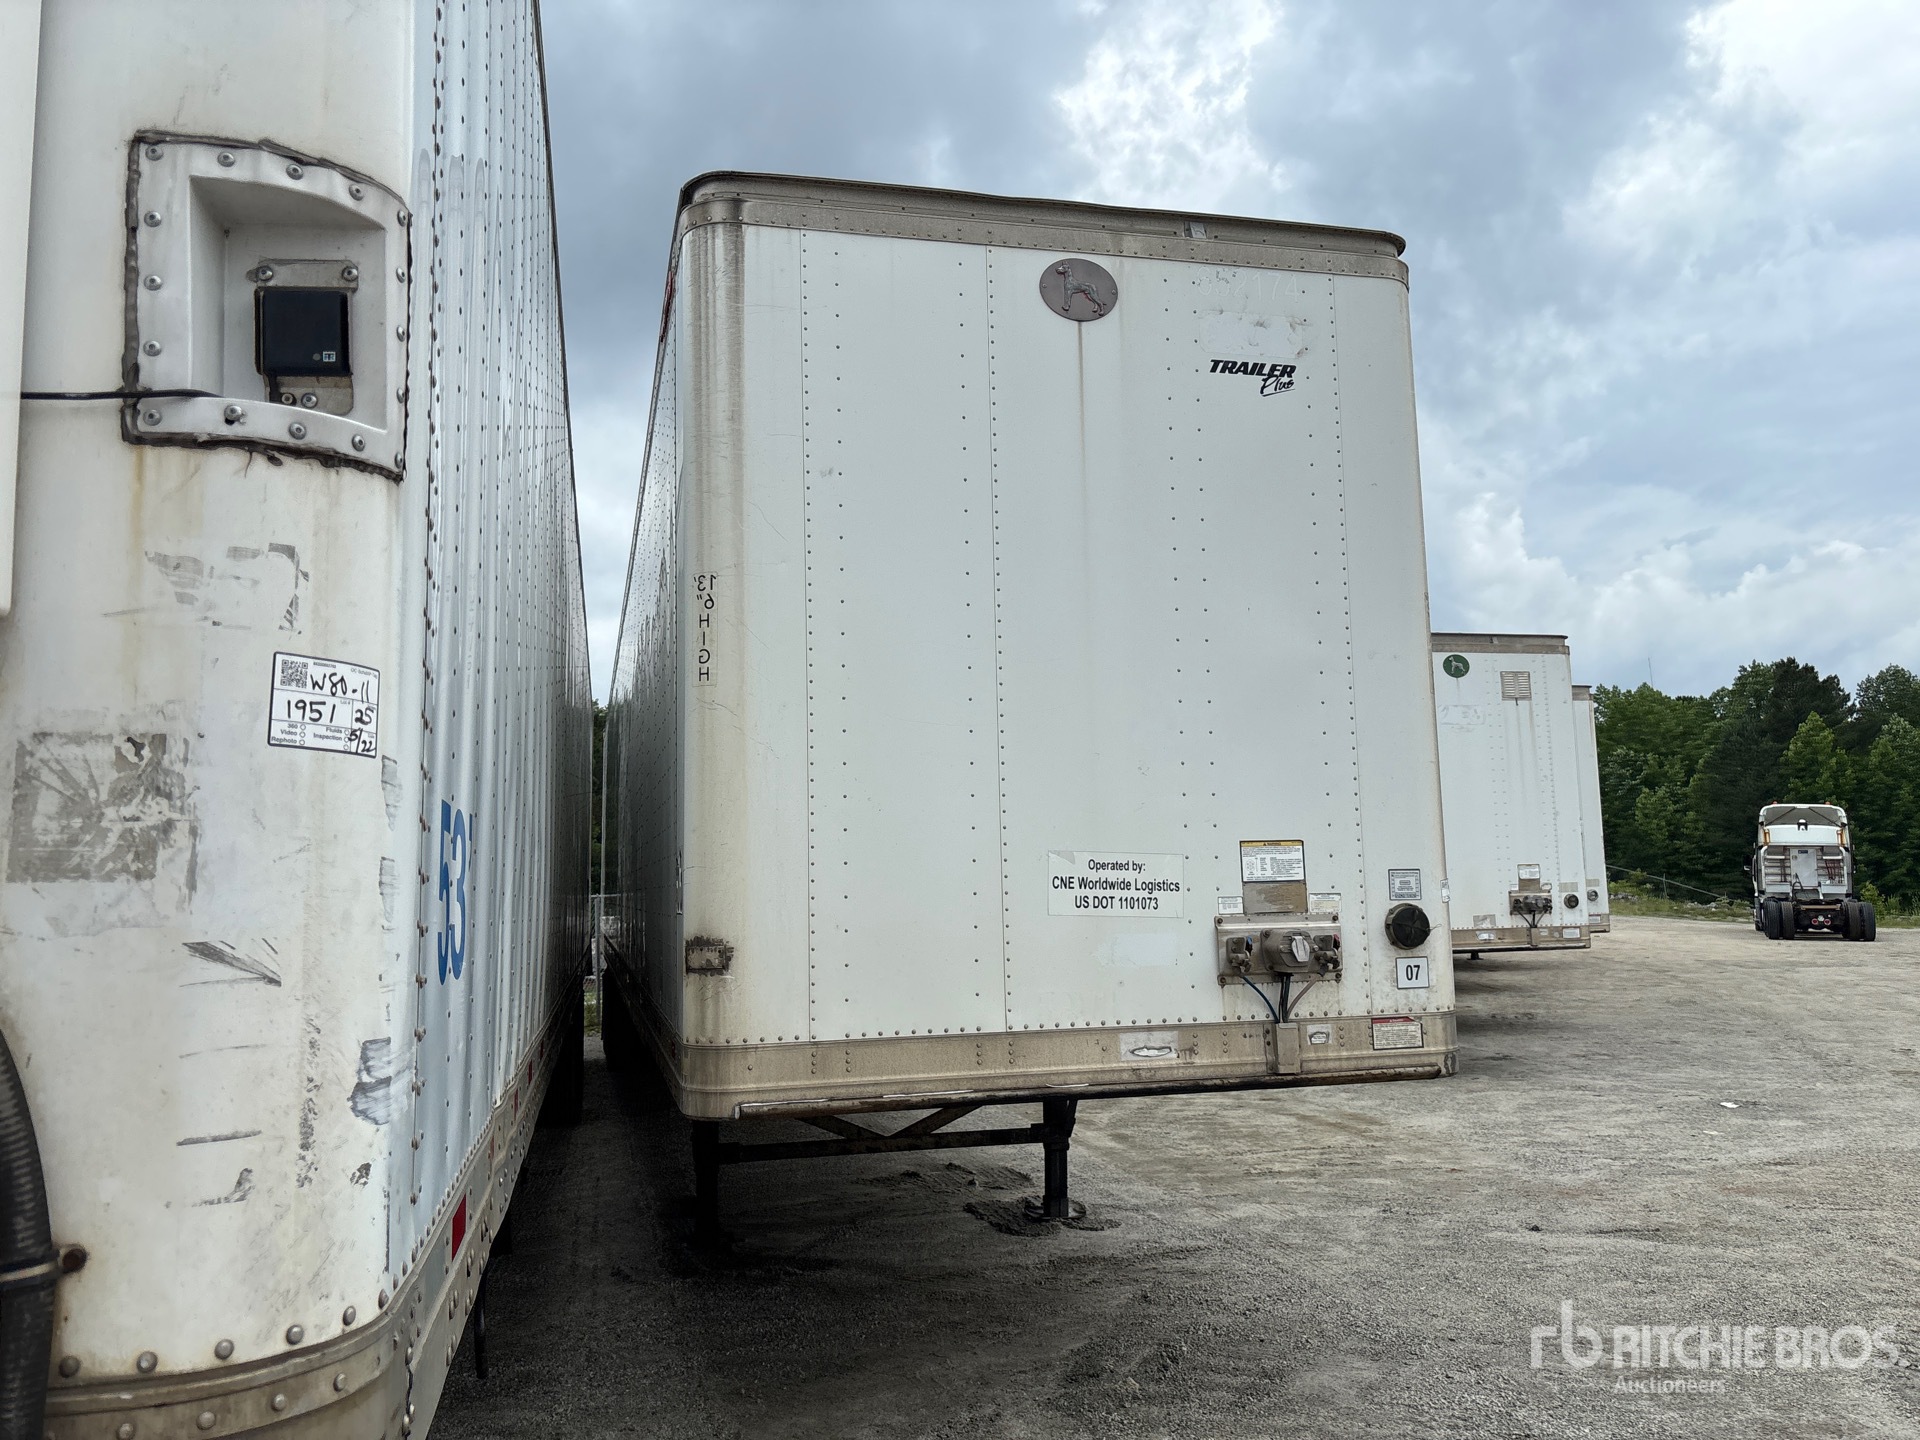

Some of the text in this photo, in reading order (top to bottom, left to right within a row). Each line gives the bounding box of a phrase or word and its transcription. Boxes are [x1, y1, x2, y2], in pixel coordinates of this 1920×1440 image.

[1209, 359, 1297, 378] TRAILER
[1259, 375, 1295, 396] Plus
[287, 699, 336, 723] 1951
[354, 707, 374, 725] 25
[271, 736, 298, 744] Rephoto
[313, 733, 343, 741] Inspection
[1088, 858, 1146, 874] Operated by:
[1052, 875, 1181, 895] CNE Worldwide Logistics
[1074, 895, 1159, 910] US DOT 1101073
[1405, 964, 1421, 981] 07
